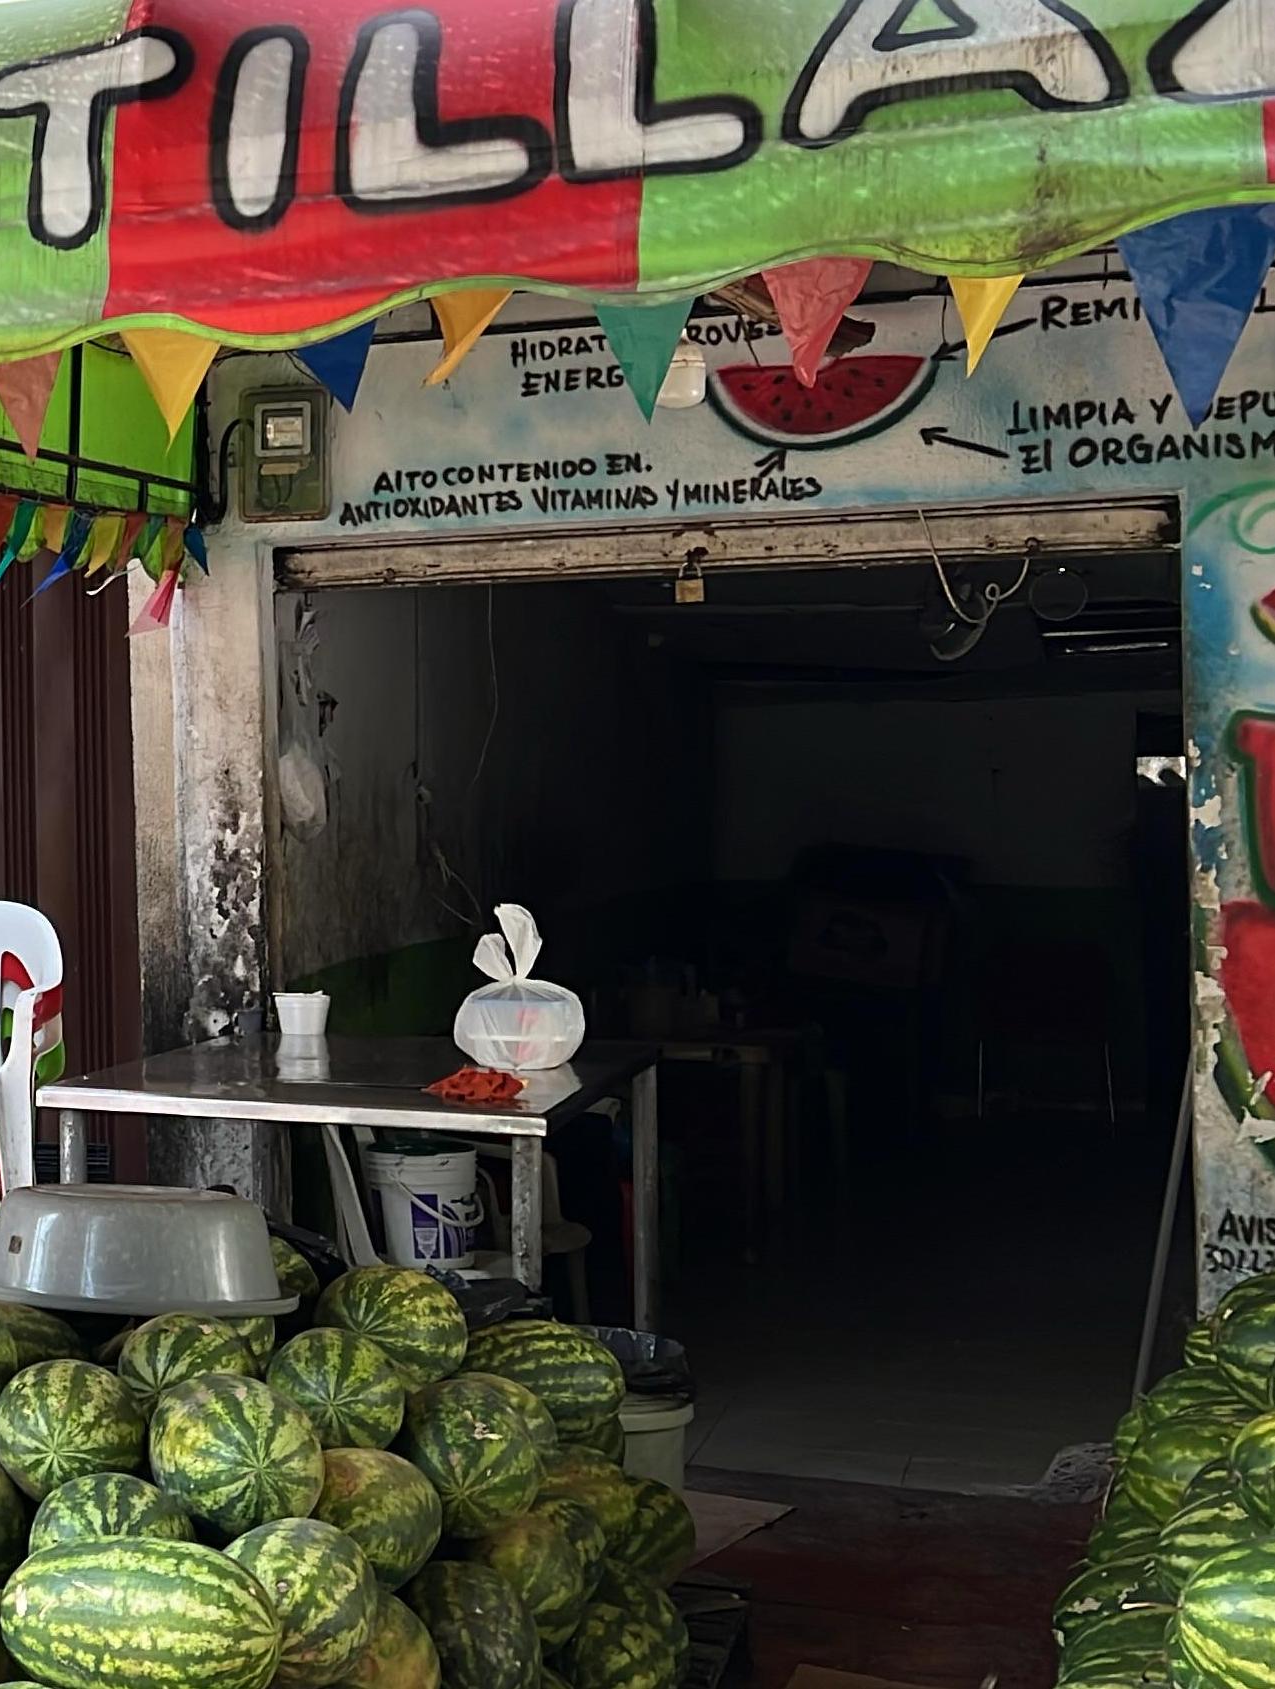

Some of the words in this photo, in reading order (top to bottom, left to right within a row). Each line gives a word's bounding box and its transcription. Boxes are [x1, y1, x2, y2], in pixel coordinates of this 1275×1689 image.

[1007, 398, 1137, 436] LIMPIA
[1150, 394, 1173, 424] Y
[443, 458, 597, 487] CONTENIDO
[339, 490, 523, 527] ANTIOXIDANTES
[533, 484, 659, 514] VITAMINAS
